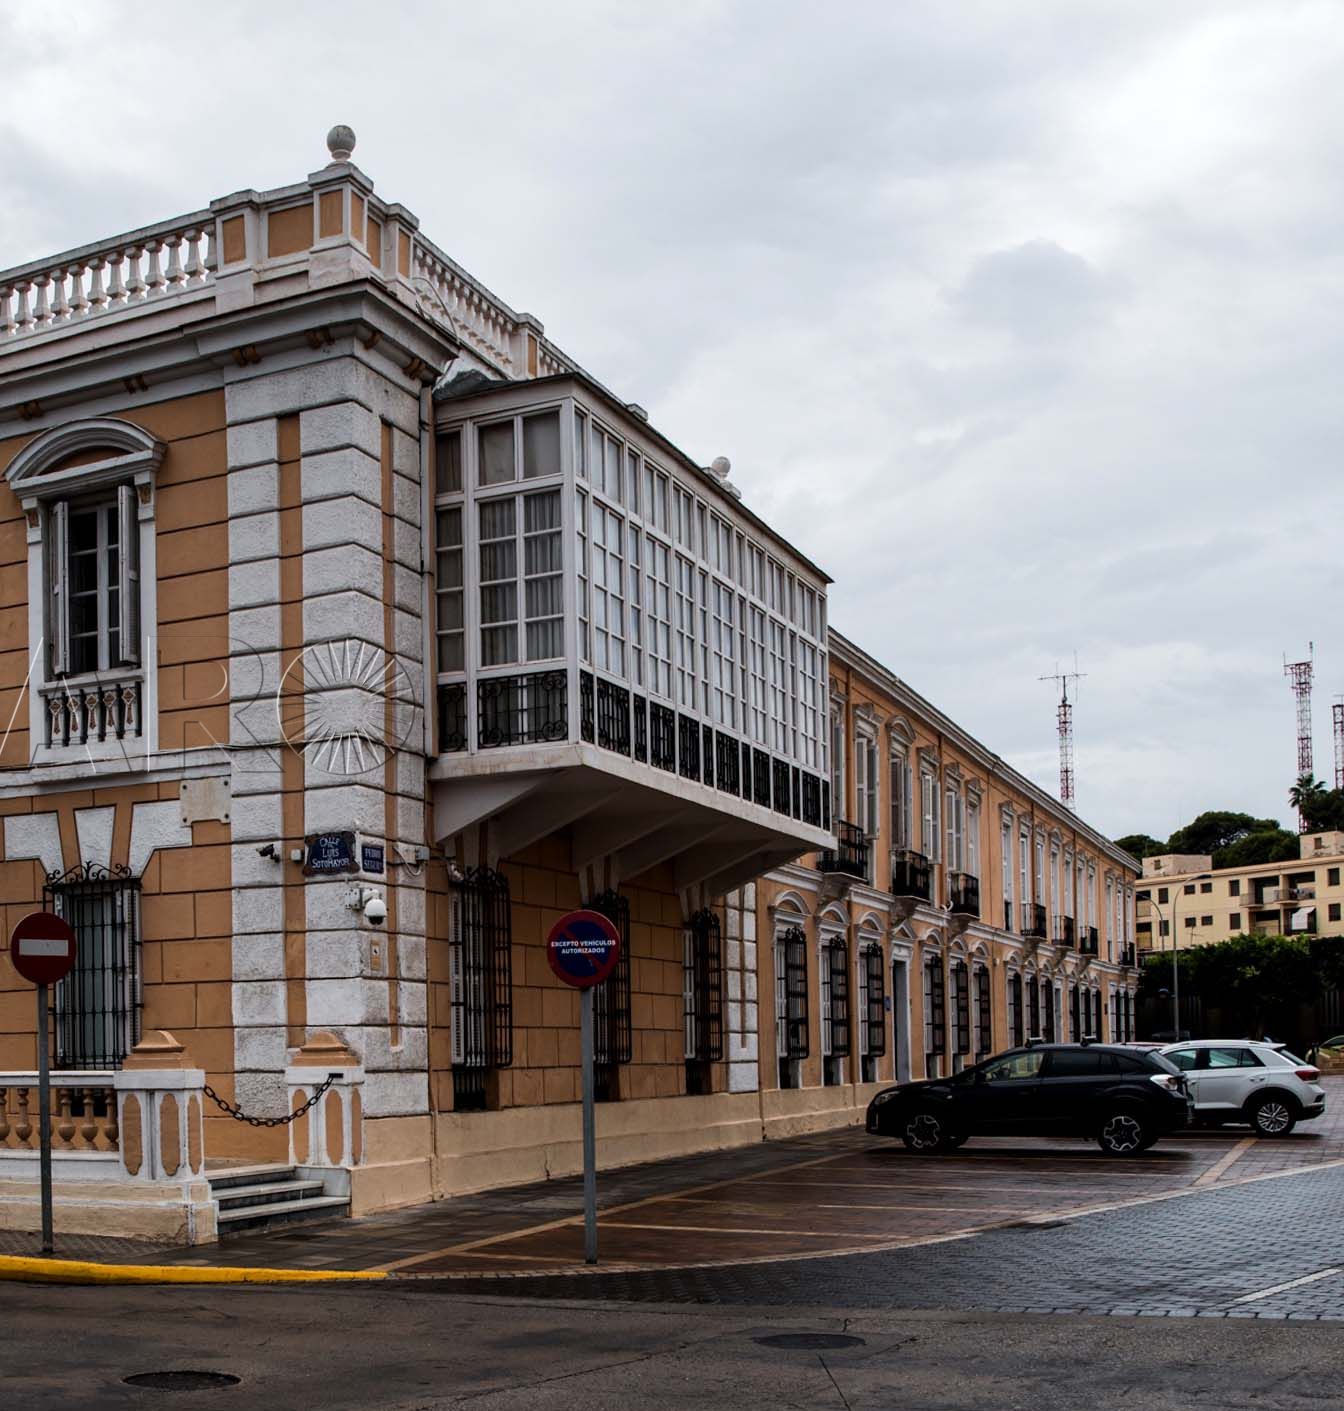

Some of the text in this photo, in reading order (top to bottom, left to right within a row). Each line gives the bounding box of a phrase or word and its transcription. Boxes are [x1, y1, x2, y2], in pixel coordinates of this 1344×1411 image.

[319, 836, 340, 848] CALLE
[322, 848, 340, 858] LUIS
[312, 857, 350, 868] SOTOMAYOR
